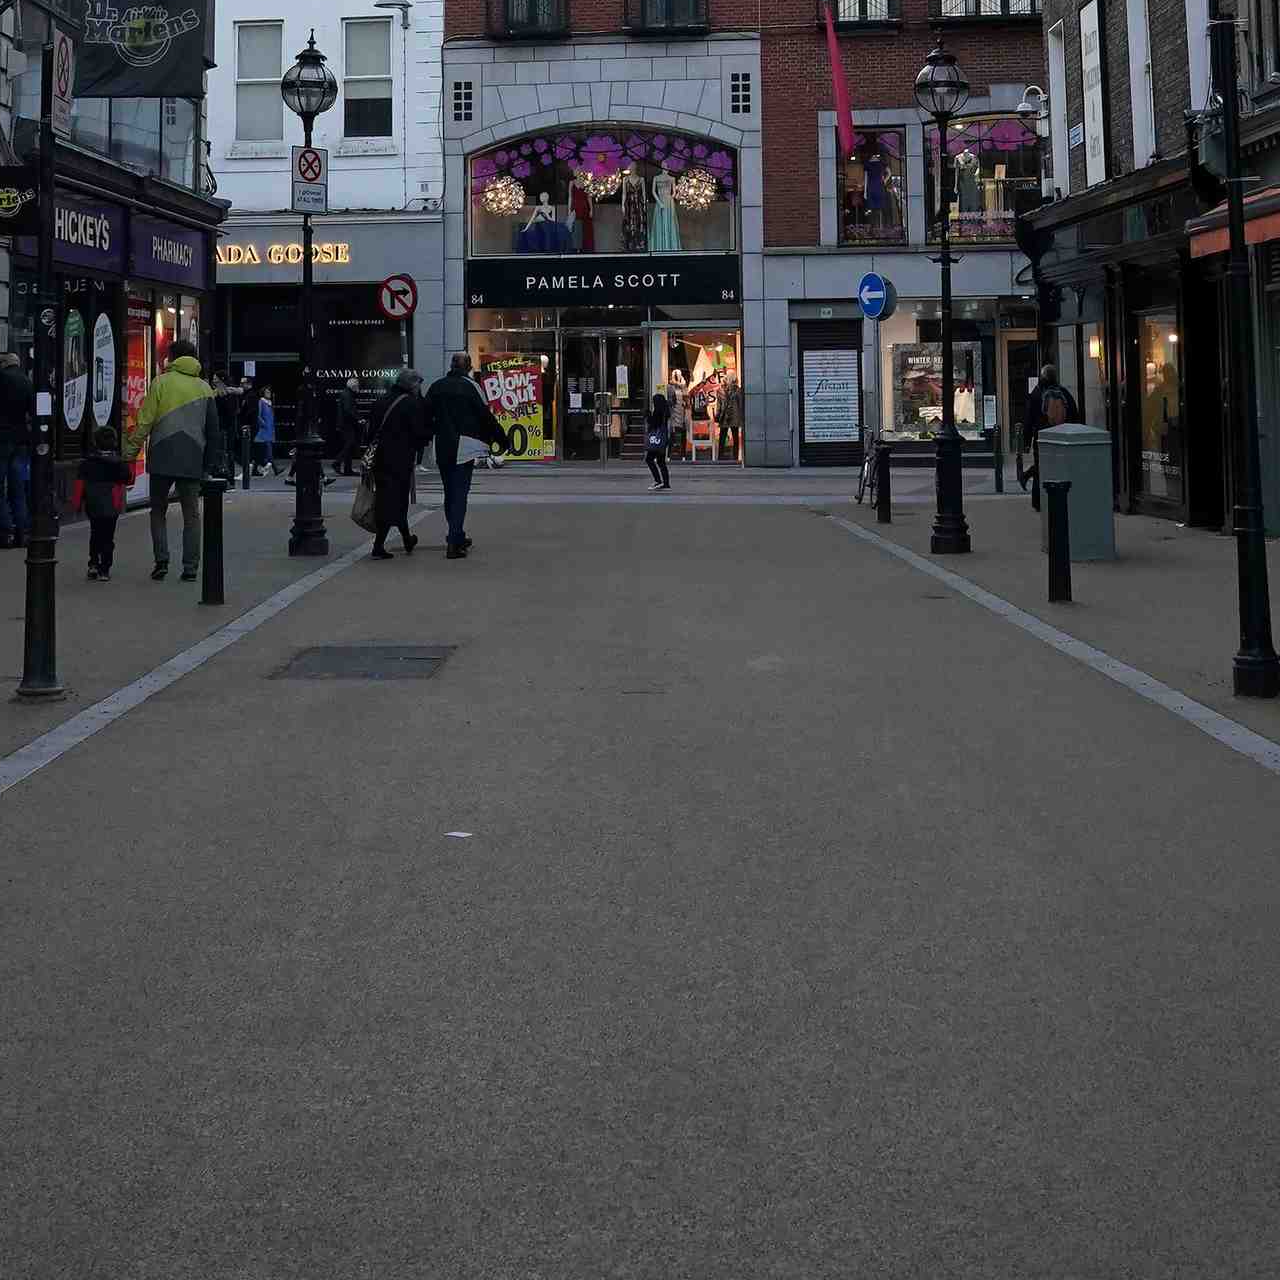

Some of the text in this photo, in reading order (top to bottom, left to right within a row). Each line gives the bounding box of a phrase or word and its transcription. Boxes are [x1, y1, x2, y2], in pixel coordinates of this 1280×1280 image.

[54, 208, 193, 269] HICKEY'S PHARMACY
[525, 273, 681, 290] PAMELA SCOTT
[471, 294, 484, 305] 84
[721, 289, 735, 300] 84
[315, 369, 398, 378] CANADA GOOSE
